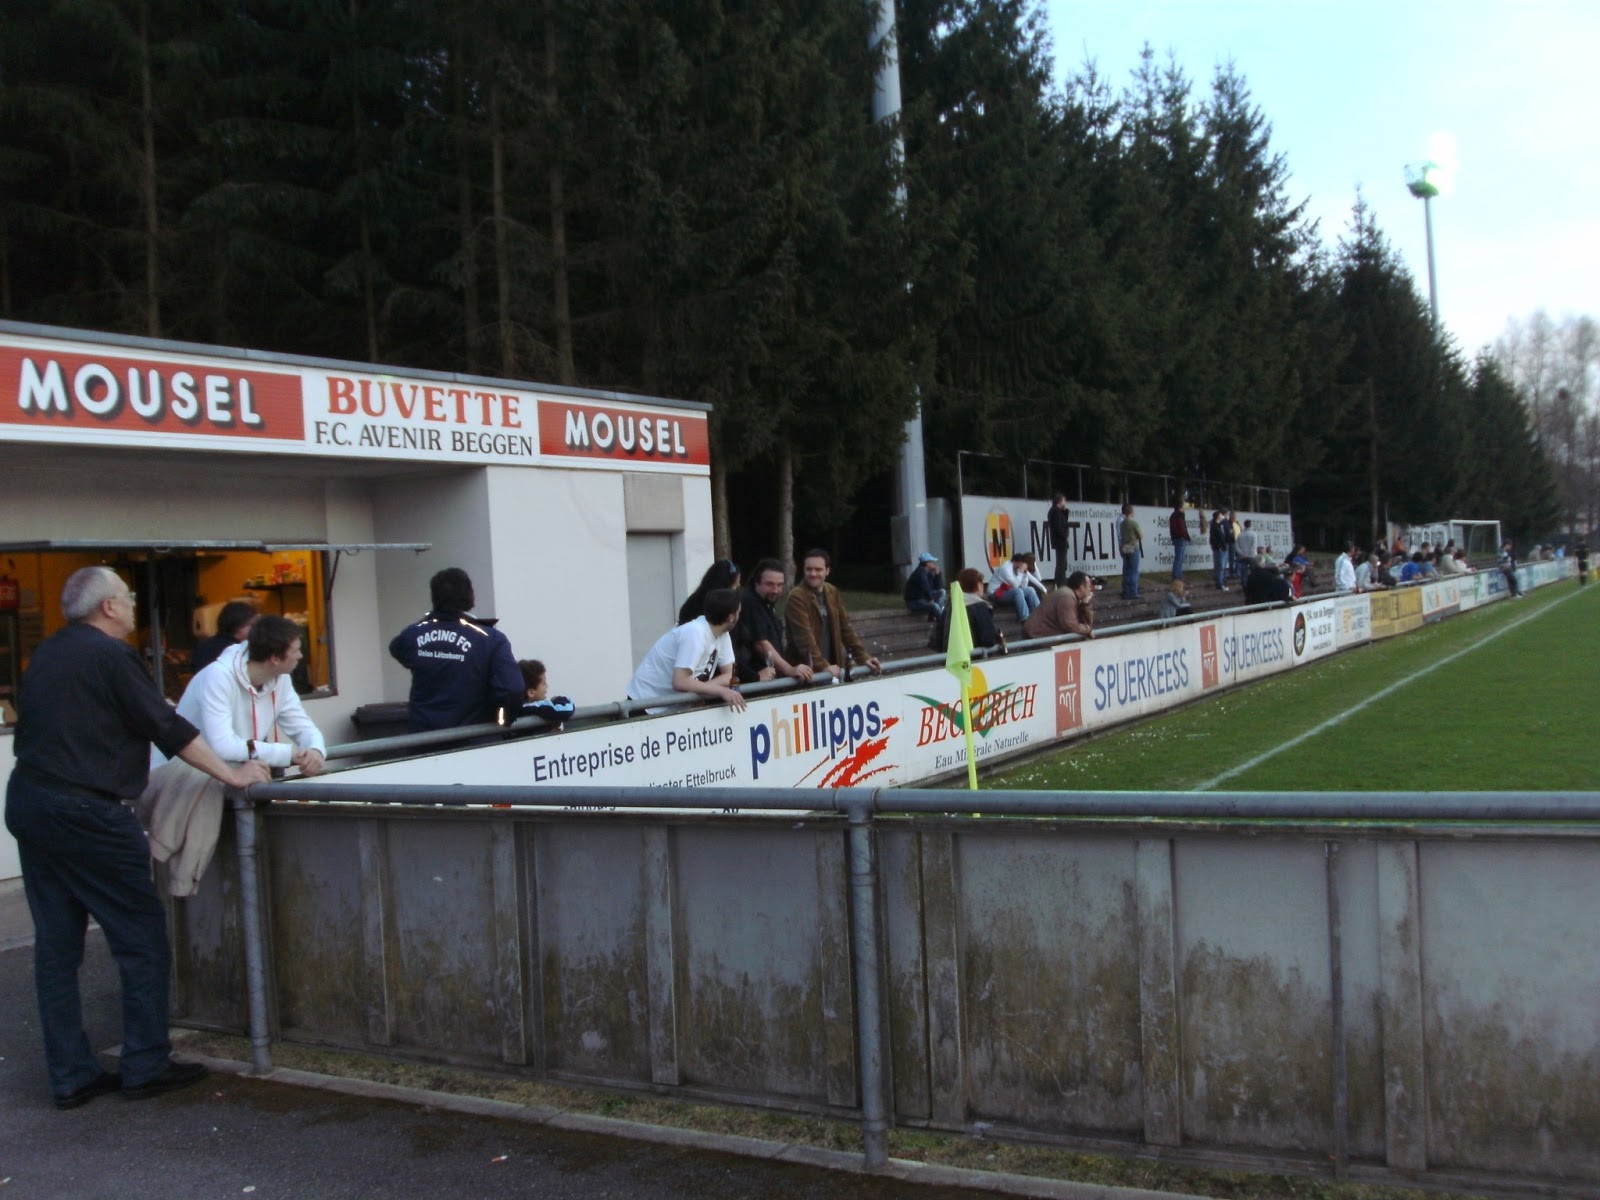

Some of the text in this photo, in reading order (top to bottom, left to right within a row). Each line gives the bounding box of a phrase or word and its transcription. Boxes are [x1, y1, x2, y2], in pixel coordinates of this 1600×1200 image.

[18, 357, 262, 425] MOUSEL
[325, 375, 522, 429] BUVETTE
[314, 421, 533, 457] F.C. AVENIR BEGGEN
[565, 409, 686, 454] MOUSEL
[417, 630, 472, 652] RACING FC
[1223, 628, 1284, 673] SPUERKEESS
[1094, 648, 1189, 711] SPUERKEESS
[533, 725, 733, 782] Entreprise de Peinture
[750, 699, 881, 780] phillipps
[935, 755, 953, 769] Eau
[994, 731, 1029, 752] Naturelle
[686, 764, 736, 788] Ettelbruck
